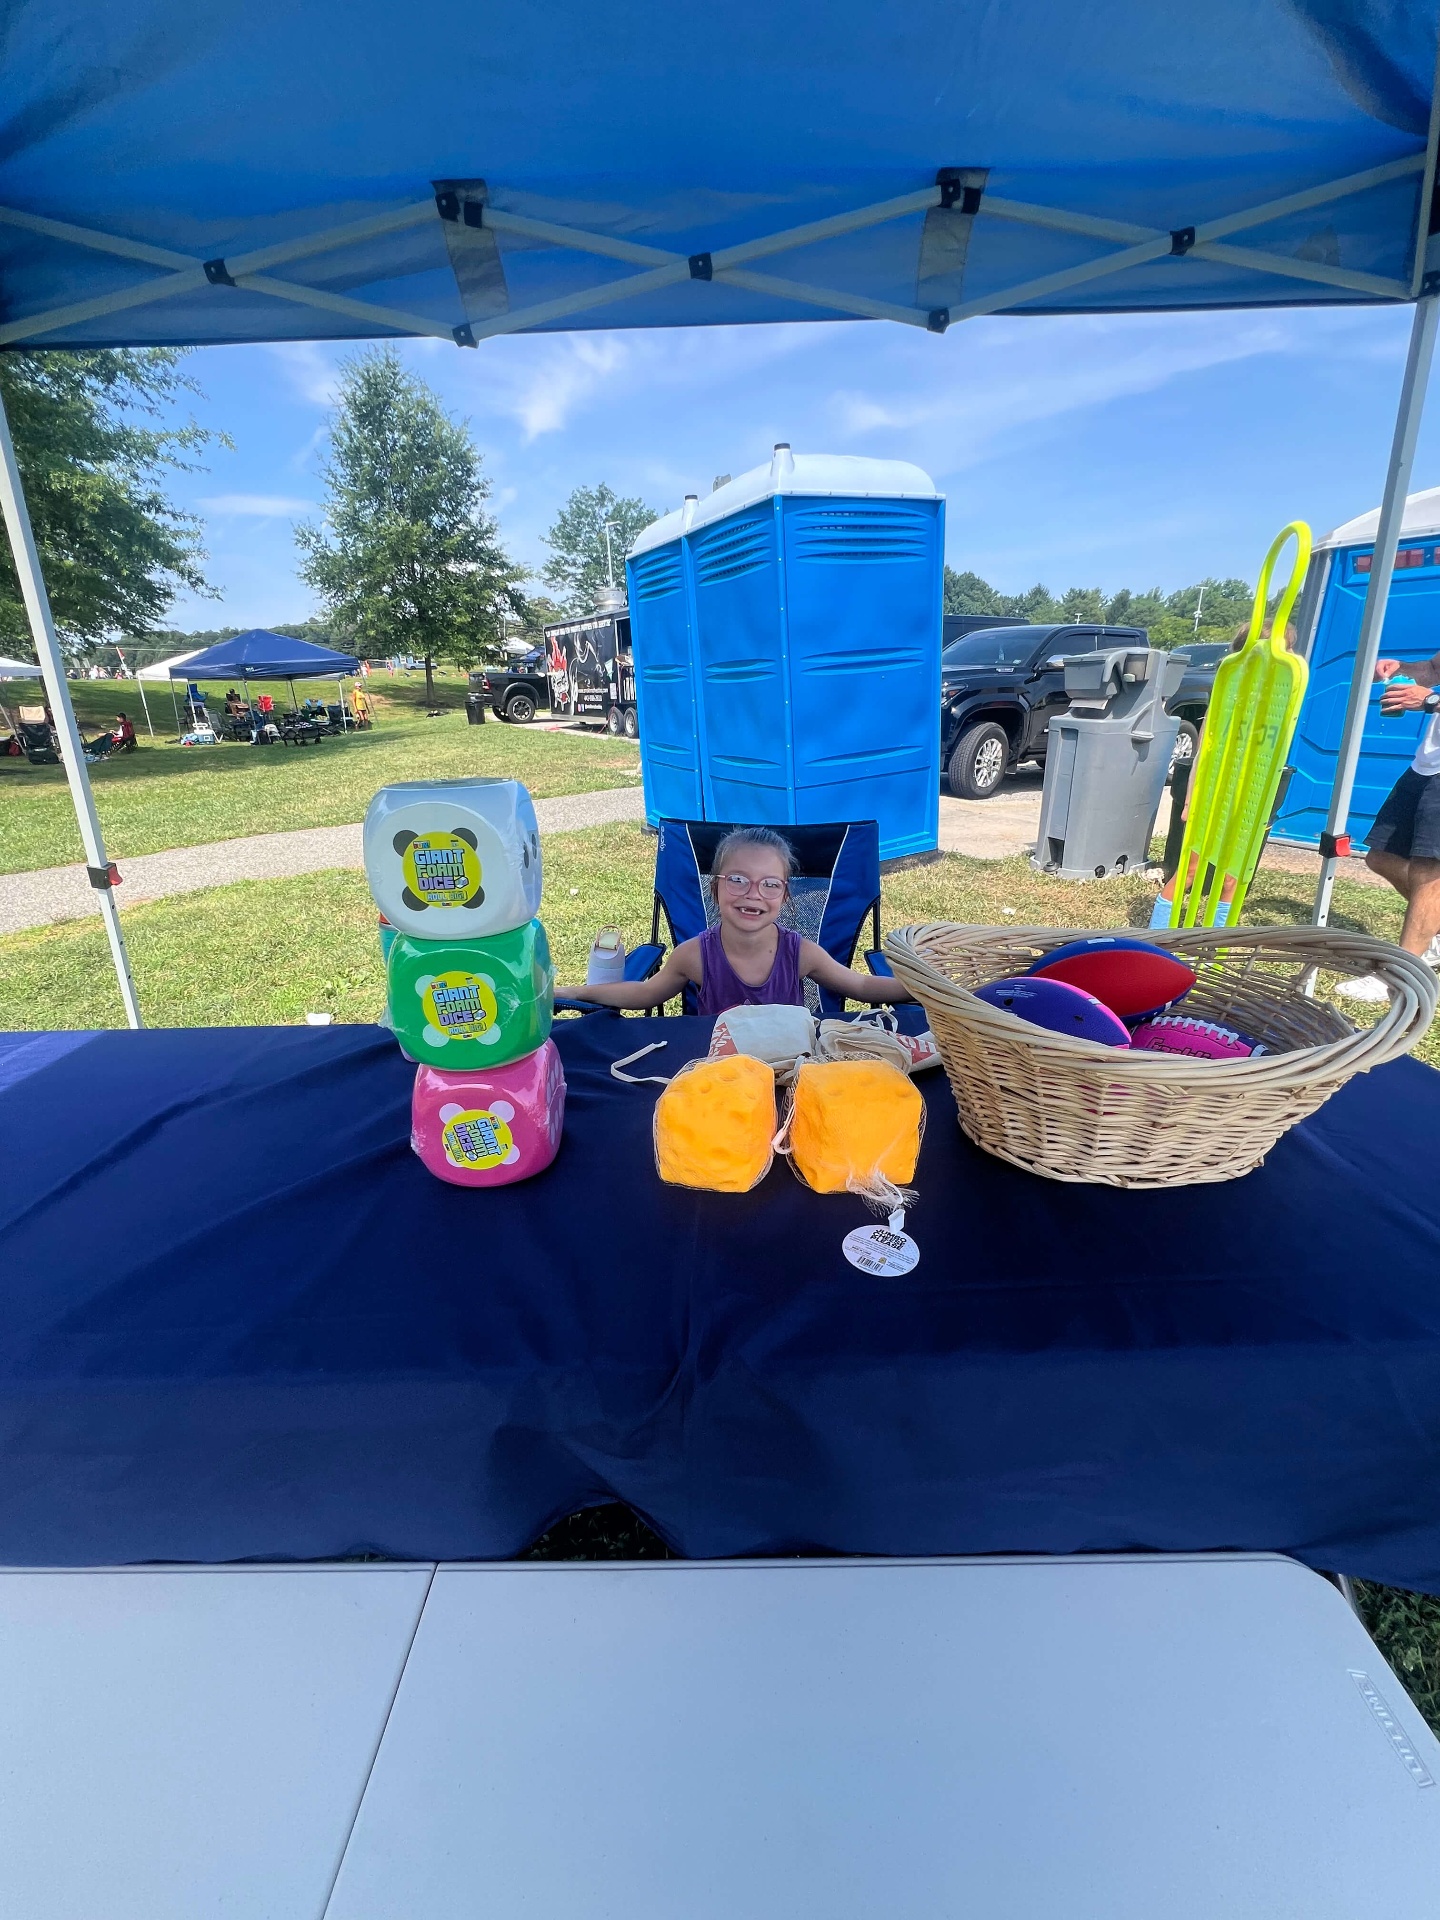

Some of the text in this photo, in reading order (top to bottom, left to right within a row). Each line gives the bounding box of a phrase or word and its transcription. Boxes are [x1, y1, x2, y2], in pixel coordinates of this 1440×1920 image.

[414, 849, 465, 864] GIANT
[416, 863, 465, 878] FOAM
[418, 876, 455, 891] DICE
[432, 985, 480, 1003] GIANT
[435, 998, 481, 1014] FOAM
[438, 1010, 474, 1026] DICE
[453, 1123, 475, 1152] DICE
[465, 1120, 490, 1157] FOAM
[476, 1117, 502, 1156] GIANT
